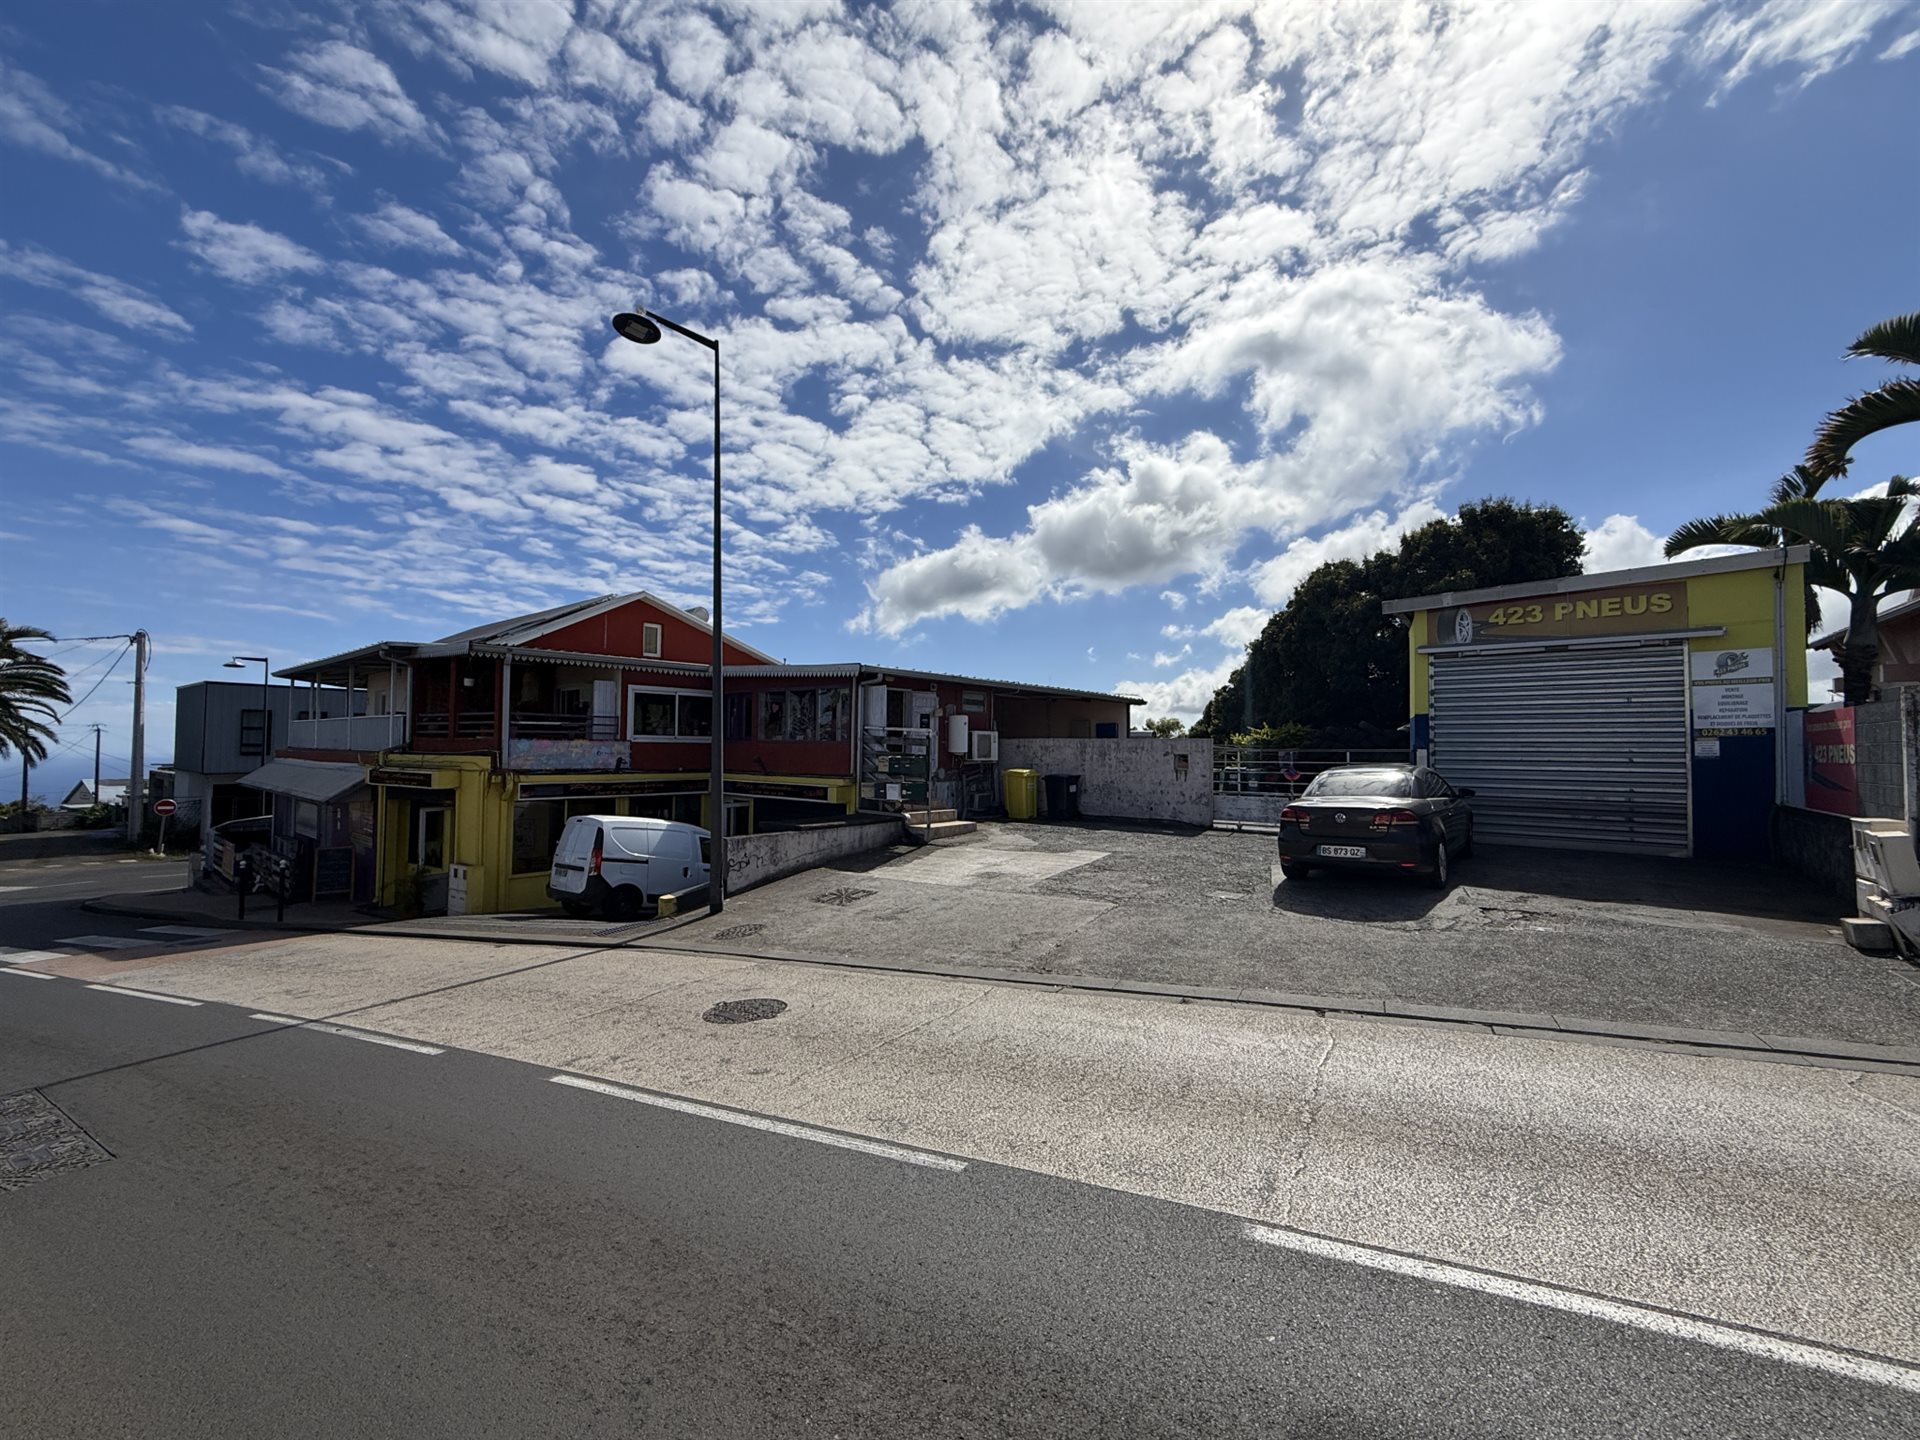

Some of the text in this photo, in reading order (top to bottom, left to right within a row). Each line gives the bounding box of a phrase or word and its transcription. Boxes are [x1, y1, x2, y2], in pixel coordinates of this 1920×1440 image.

[1488, 593, 1673, 625] 423 PNEUS
[1701, 728, 1768, 736] 0262 43 46 65
[1814, 744, 1856, 765] 423 PNEUS
